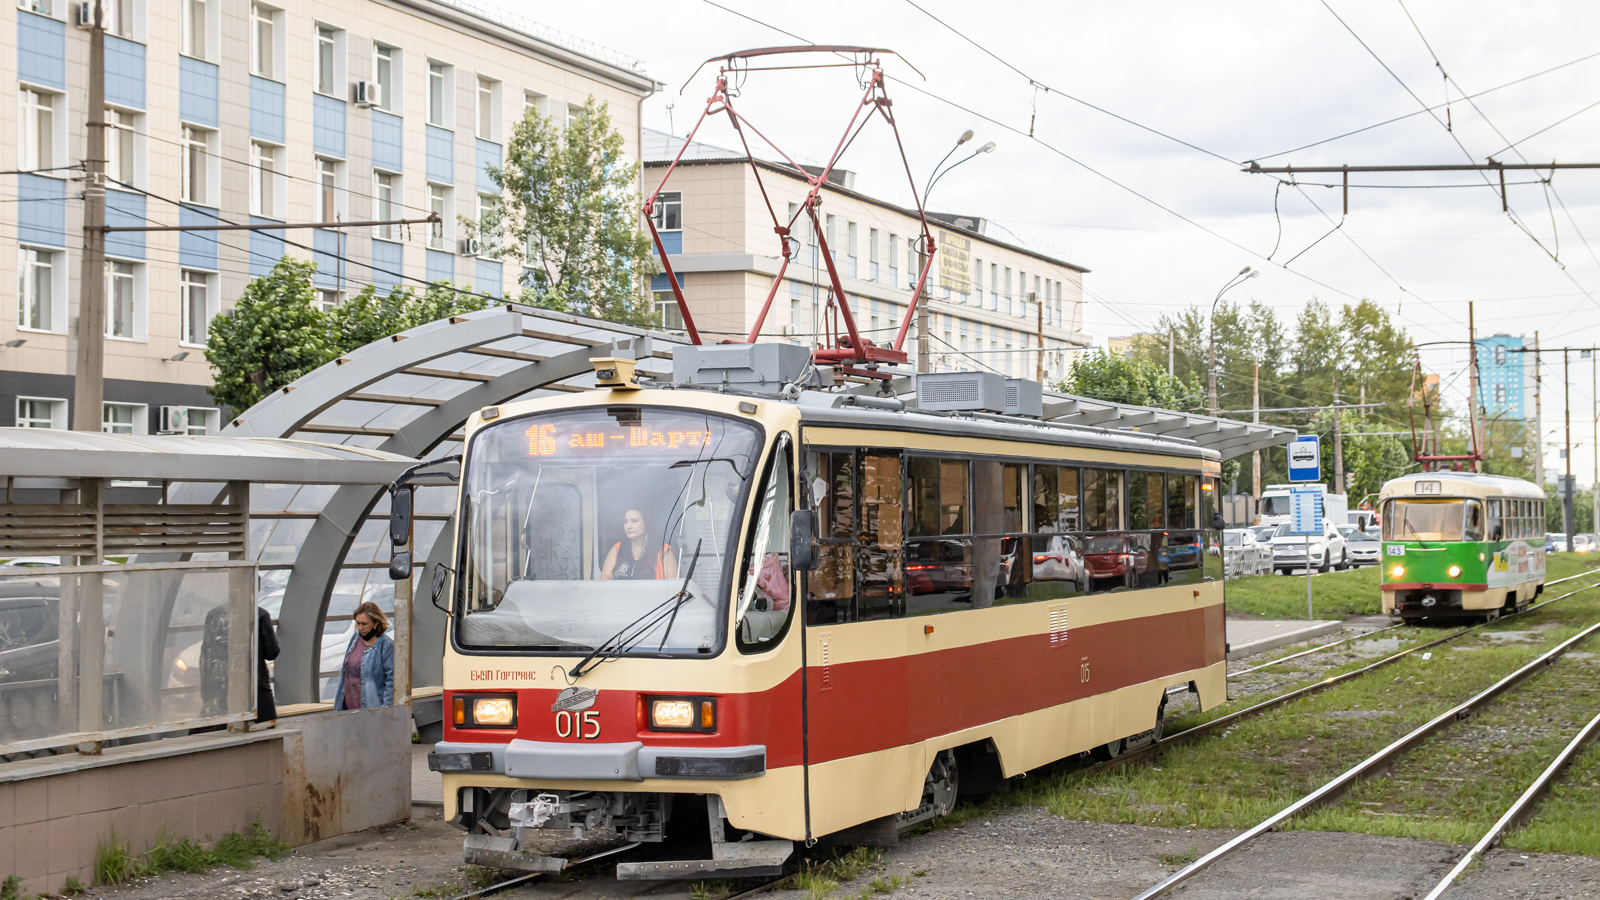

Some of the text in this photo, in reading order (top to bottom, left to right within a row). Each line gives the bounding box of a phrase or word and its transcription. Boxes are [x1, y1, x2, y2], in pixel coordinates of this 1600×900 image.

[942, 245, 969, 262] СКЛАДЫ
[943, 257, 968, 273] ОФИСЫ
[525, 425, 556, 455] 16
[1420, 482, 1433, 493] 14
[1388, 547, 1401, 555] 543
[470, 669, 493, 681] ЕМУП
[555, 710, 601, 739] 015
